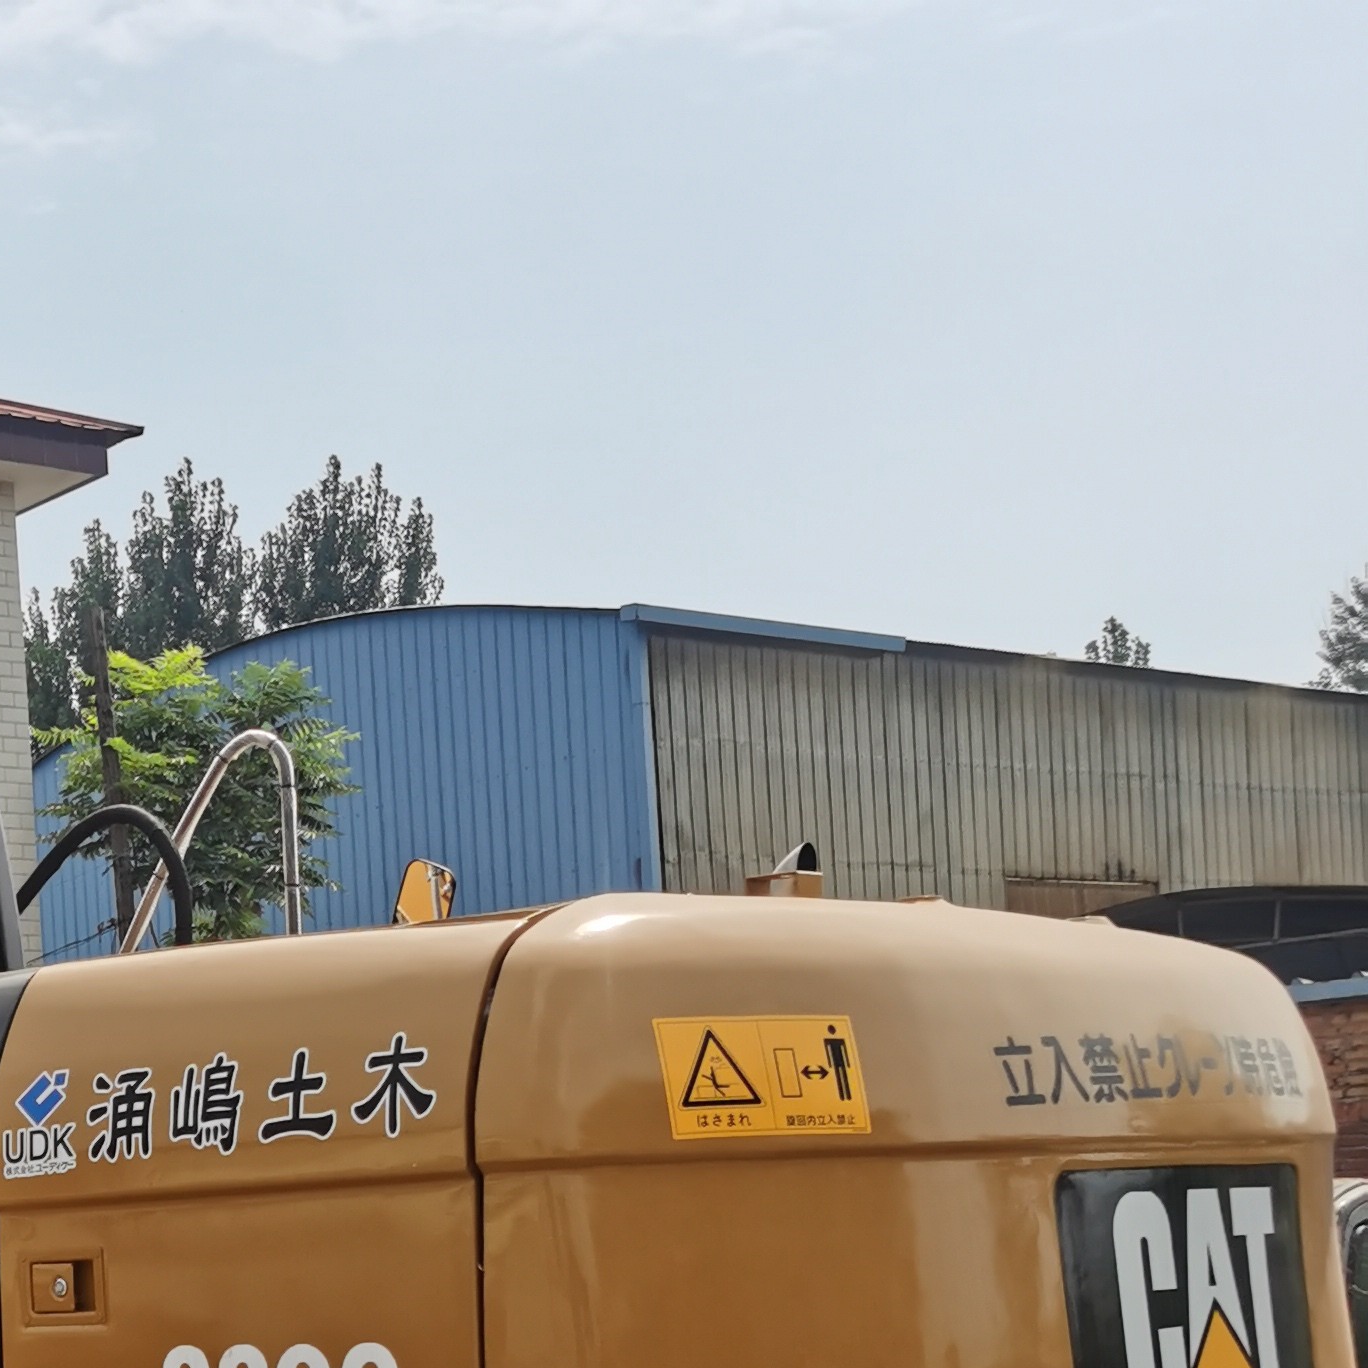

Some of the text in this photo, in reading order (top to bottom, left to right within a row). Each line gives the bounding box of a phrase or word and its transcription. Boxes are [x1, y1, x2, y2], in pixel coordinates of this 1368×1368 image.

[86, 1031, 437, 1163] 涌嶋土木
[696, 1113, 752, 1127] はさまれ
[4, 1124, 75, 1164] UDK
